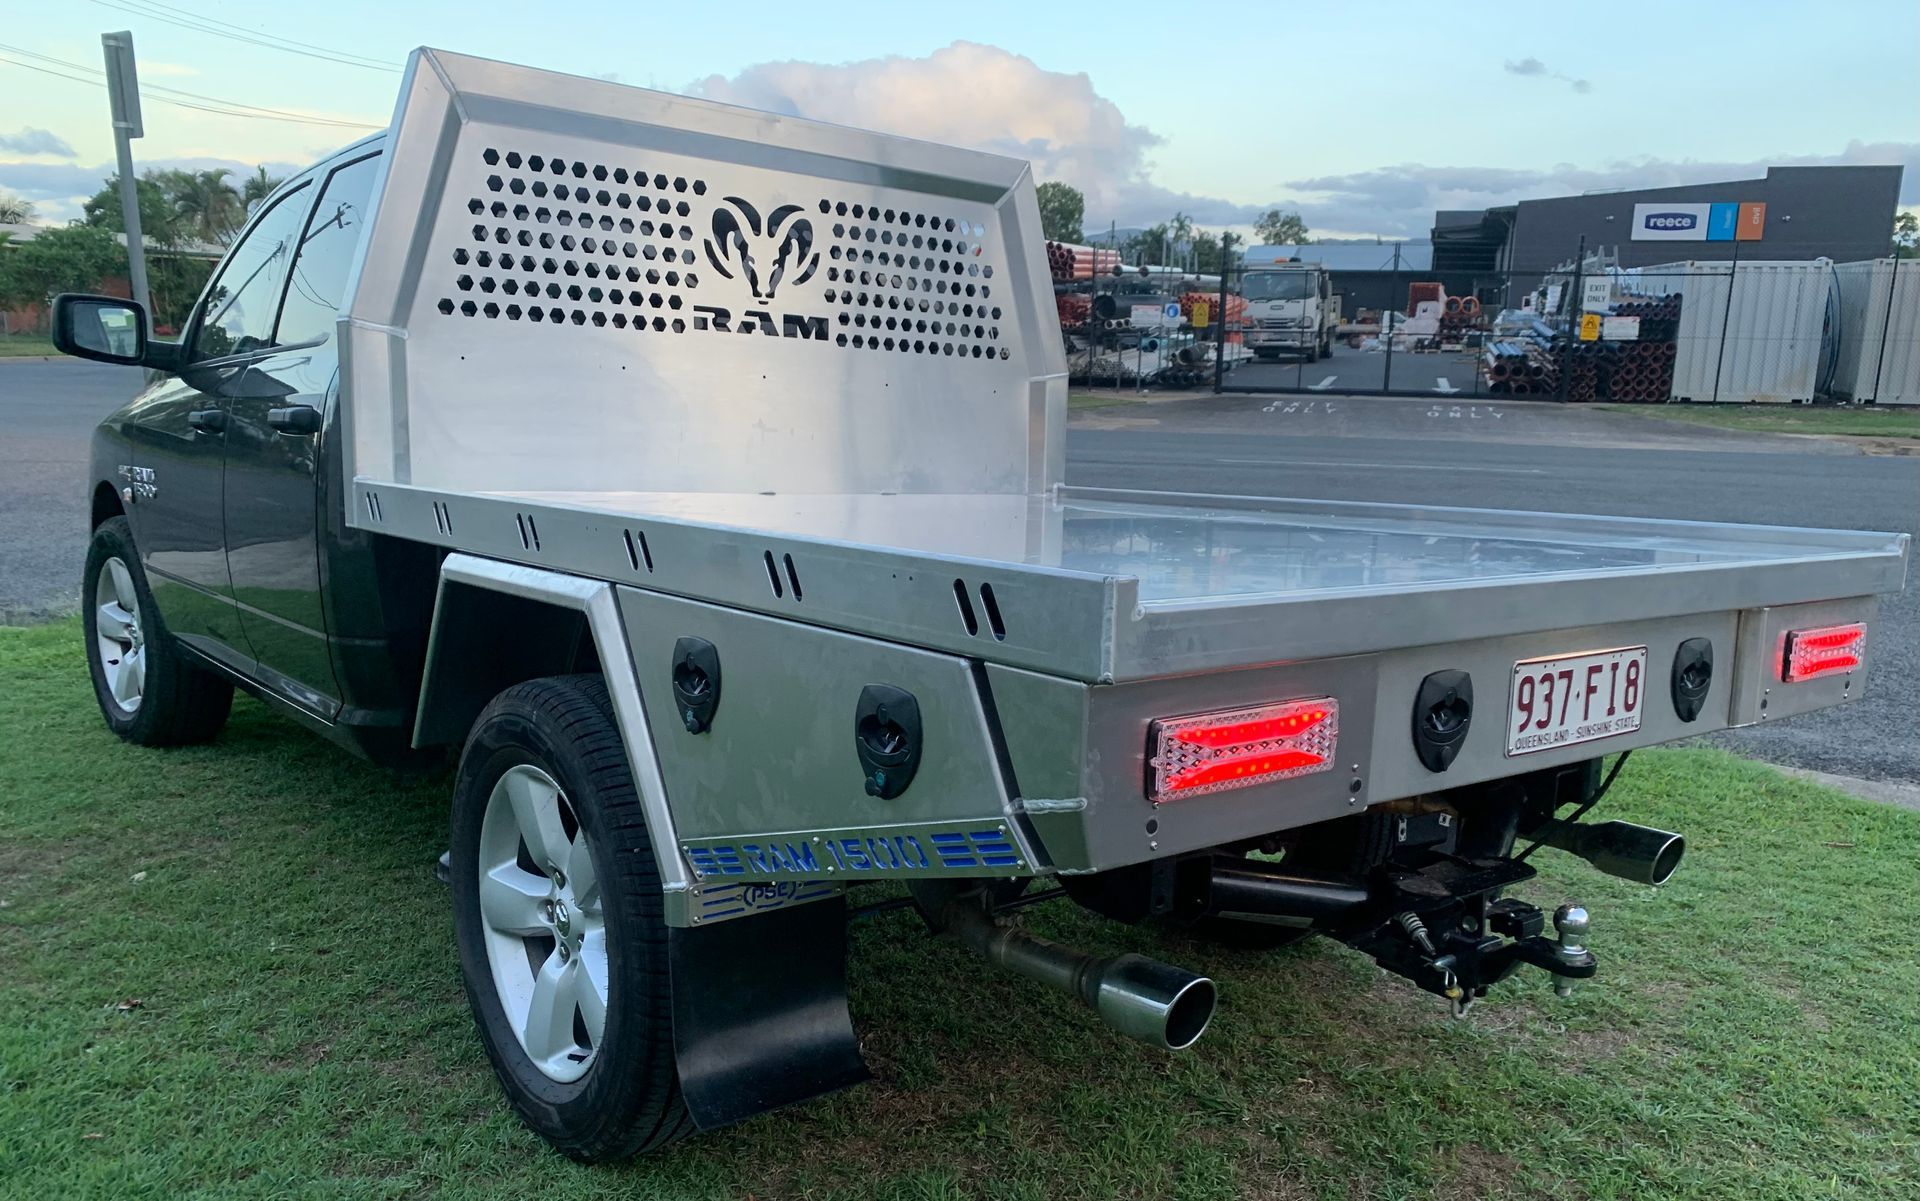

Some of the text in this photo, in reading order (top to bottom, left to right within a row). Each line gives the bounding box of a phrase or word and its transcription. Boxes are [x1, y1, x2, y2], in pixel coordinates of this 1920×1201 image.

[1752, 207, 1761, 225] civil
[1649, 217, 1692, 227] reece
[1589, 284, 1606, 292] EXIT
[1587, 295, 1606, 303] ONLY
[693, 305, 829, 341] RAM
[1262, 406, 1337, 414] ONLY
[1427, 411, 1503, 419] ONLY
[1514, 729, 1569, 750] QUEENSLAND
[1576, 721, 1612, 739] SUNSHINE
[1614, 715, 1635, 731] STATE
[742, 834, 929, 874] RAM 1500
